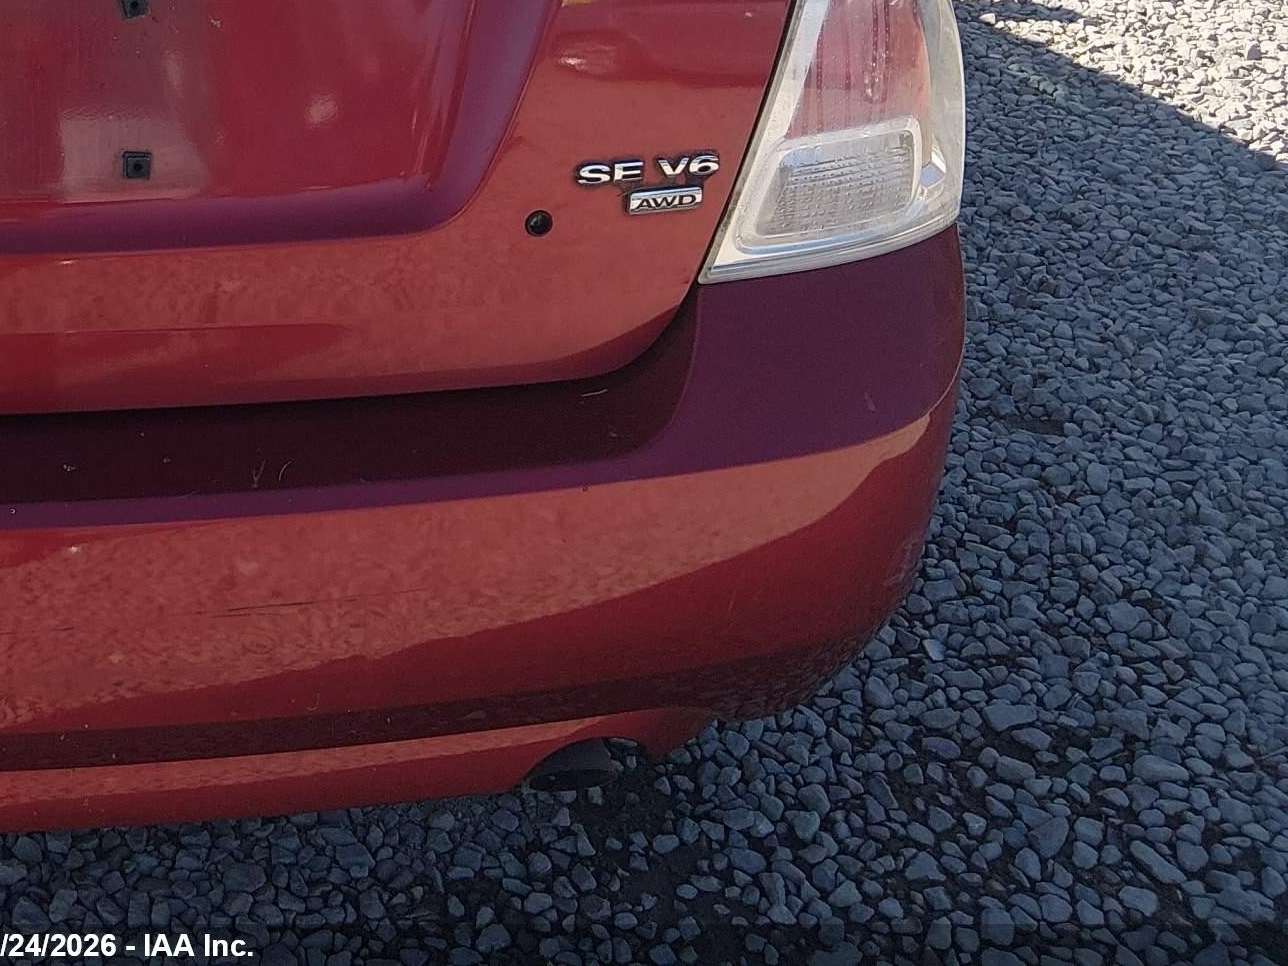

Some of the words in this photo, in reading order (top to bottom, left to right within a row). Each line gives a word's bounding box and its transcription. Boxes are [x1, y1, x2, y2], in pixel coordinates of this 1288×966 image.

[578, 161, 644, 184] SE
[658, 153, 720, 177] V6
[631, 194, 697, 211] AWD
